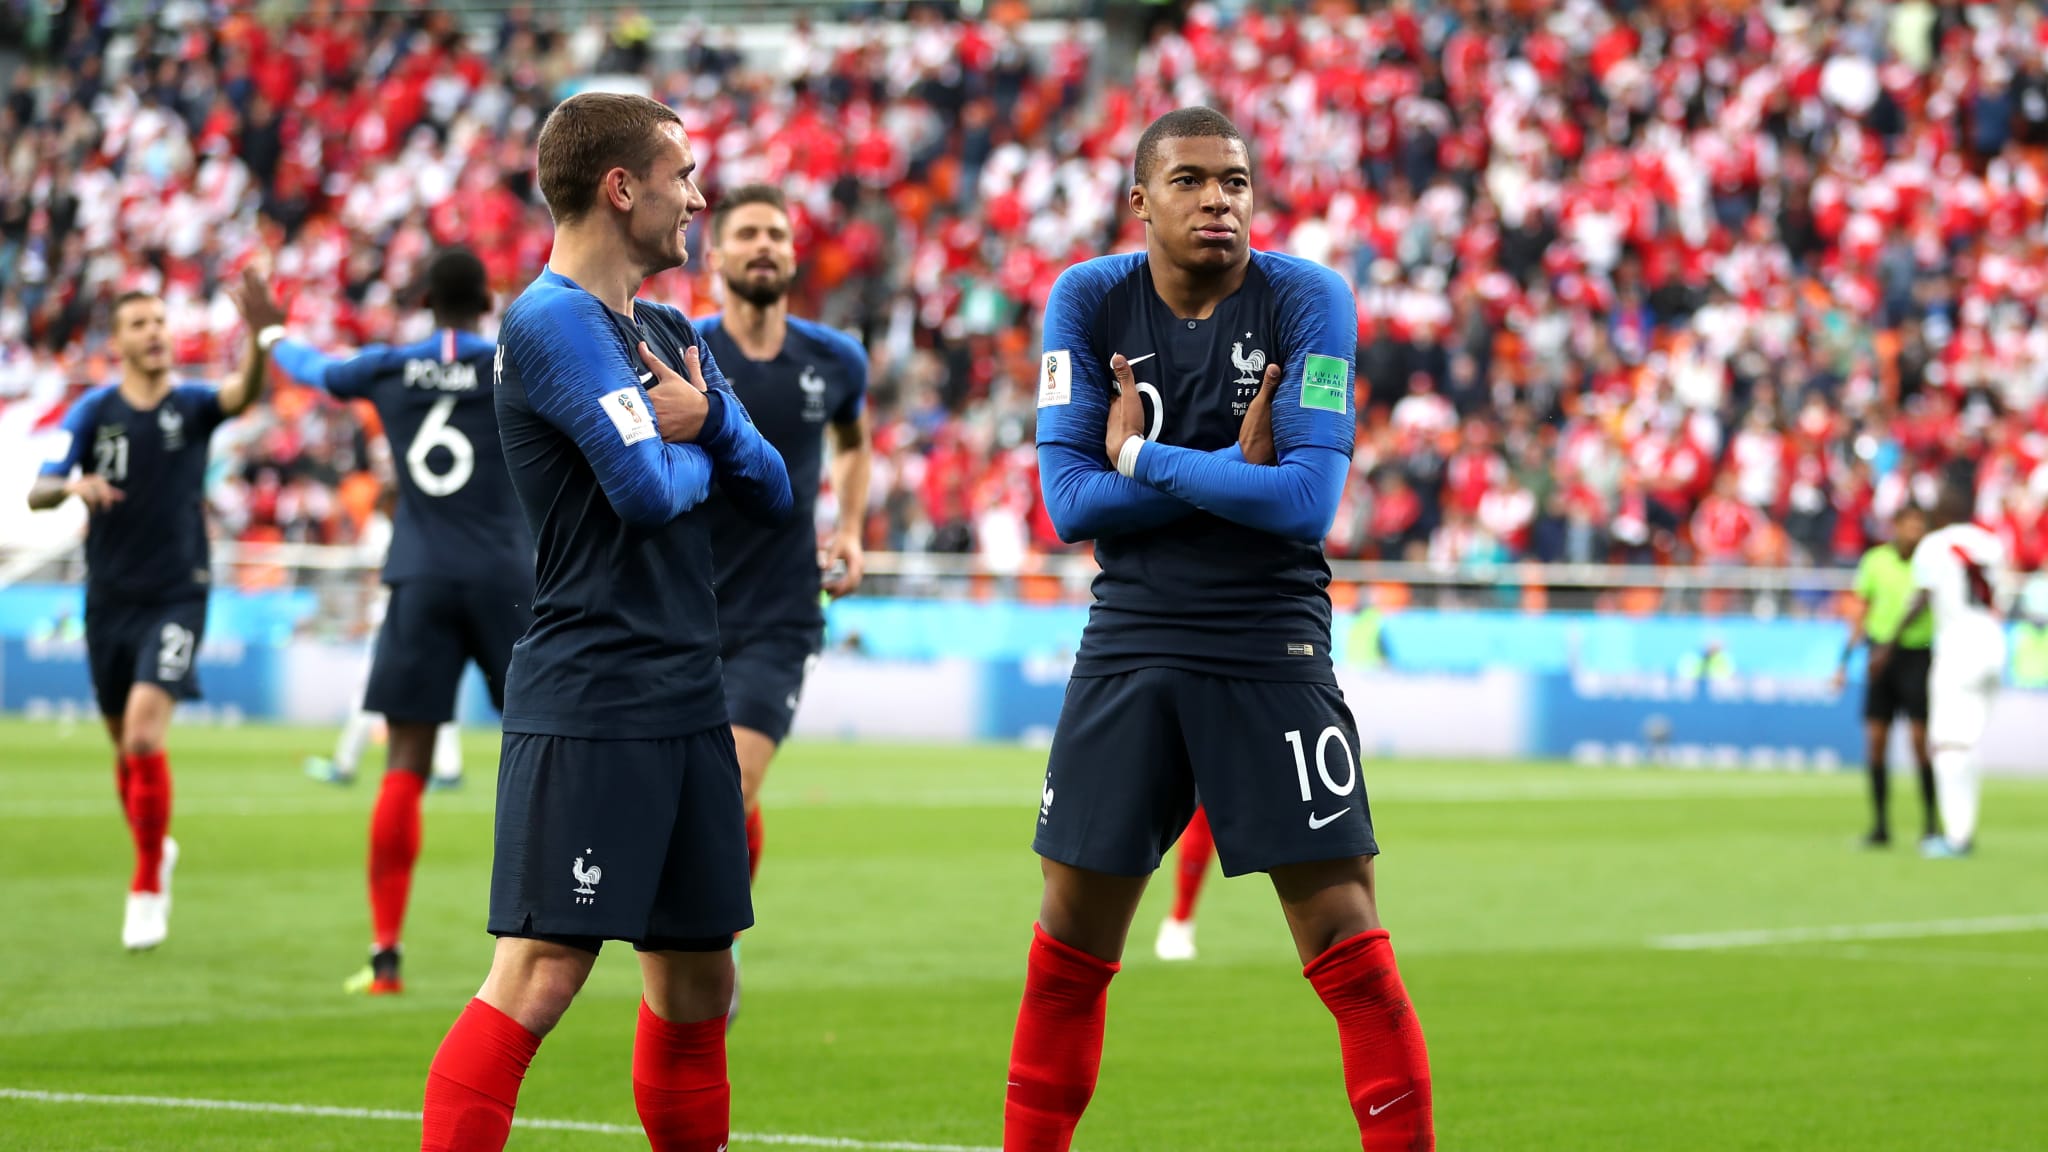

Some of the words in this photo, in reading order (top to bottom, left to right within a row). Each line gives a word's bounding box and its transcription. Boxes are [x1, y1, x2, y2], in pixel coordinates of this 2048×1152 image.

[404, 358, 478, 391] POGBA
[1237, 388, 1258, 396] FFF
[1329, 390, 1344, 399] FIFA
[95, 434, 128, 481] 21
[406, 394, 475, 497] 6
[158, 621, 195, 672] 21
[1284, 725, 1356, 803] 10
[575, 896, 594, 905] FFF
